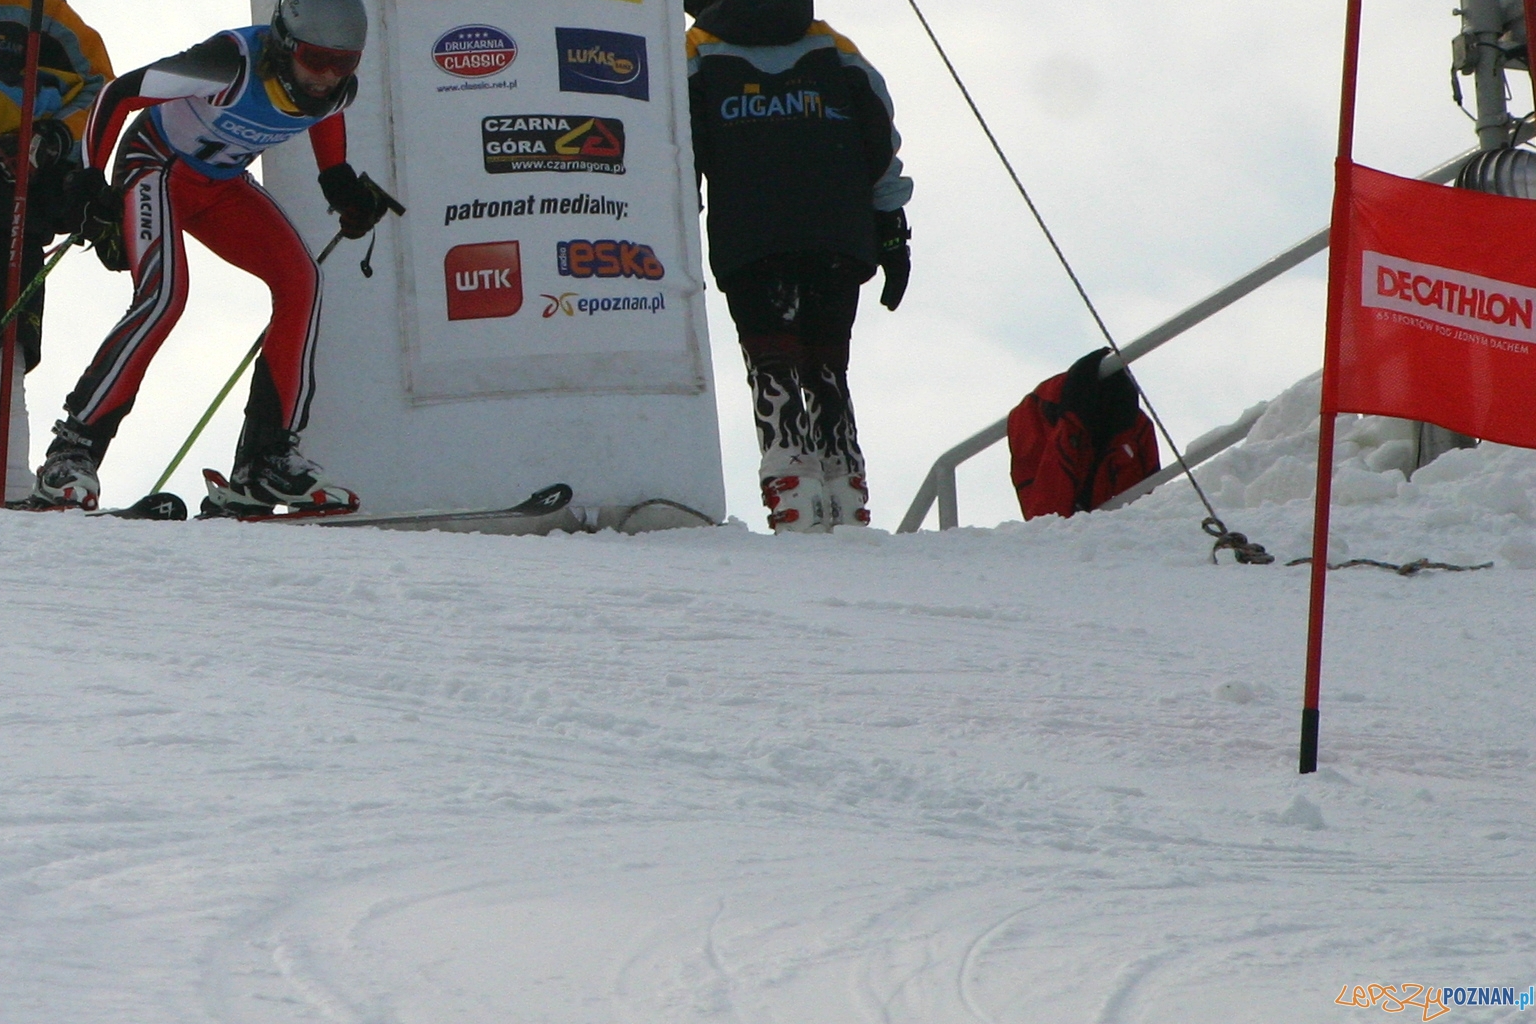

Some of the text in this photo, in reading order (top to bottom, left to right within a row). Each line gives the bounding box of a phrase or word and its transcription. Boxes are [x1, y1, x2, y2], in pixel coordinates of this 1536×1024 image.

[444, 40, 505, 52] DRUKARNIA
[444, 53, 506, 70] CLASSIC
[436, 79, 518, 93] www.classic.net.pl
[484, 117, 571, 132] CZARNA
[486, 138, 547, 154] GÓRA
[511, 159, 625, 174] www.czarnagora.pl
[139, 183, 153, 241] RACING
[444, 193, 629, 225] patronat medialny:
[455, 268, 512, 292] WTK
[577, 292, 666, 315] epoznan.pl
[1376, 265, 1533, 330] DECATHLON
[1453, 329, 1488, 345] JEDNYM
[1490, 340, 1529, 354] DACHEM
